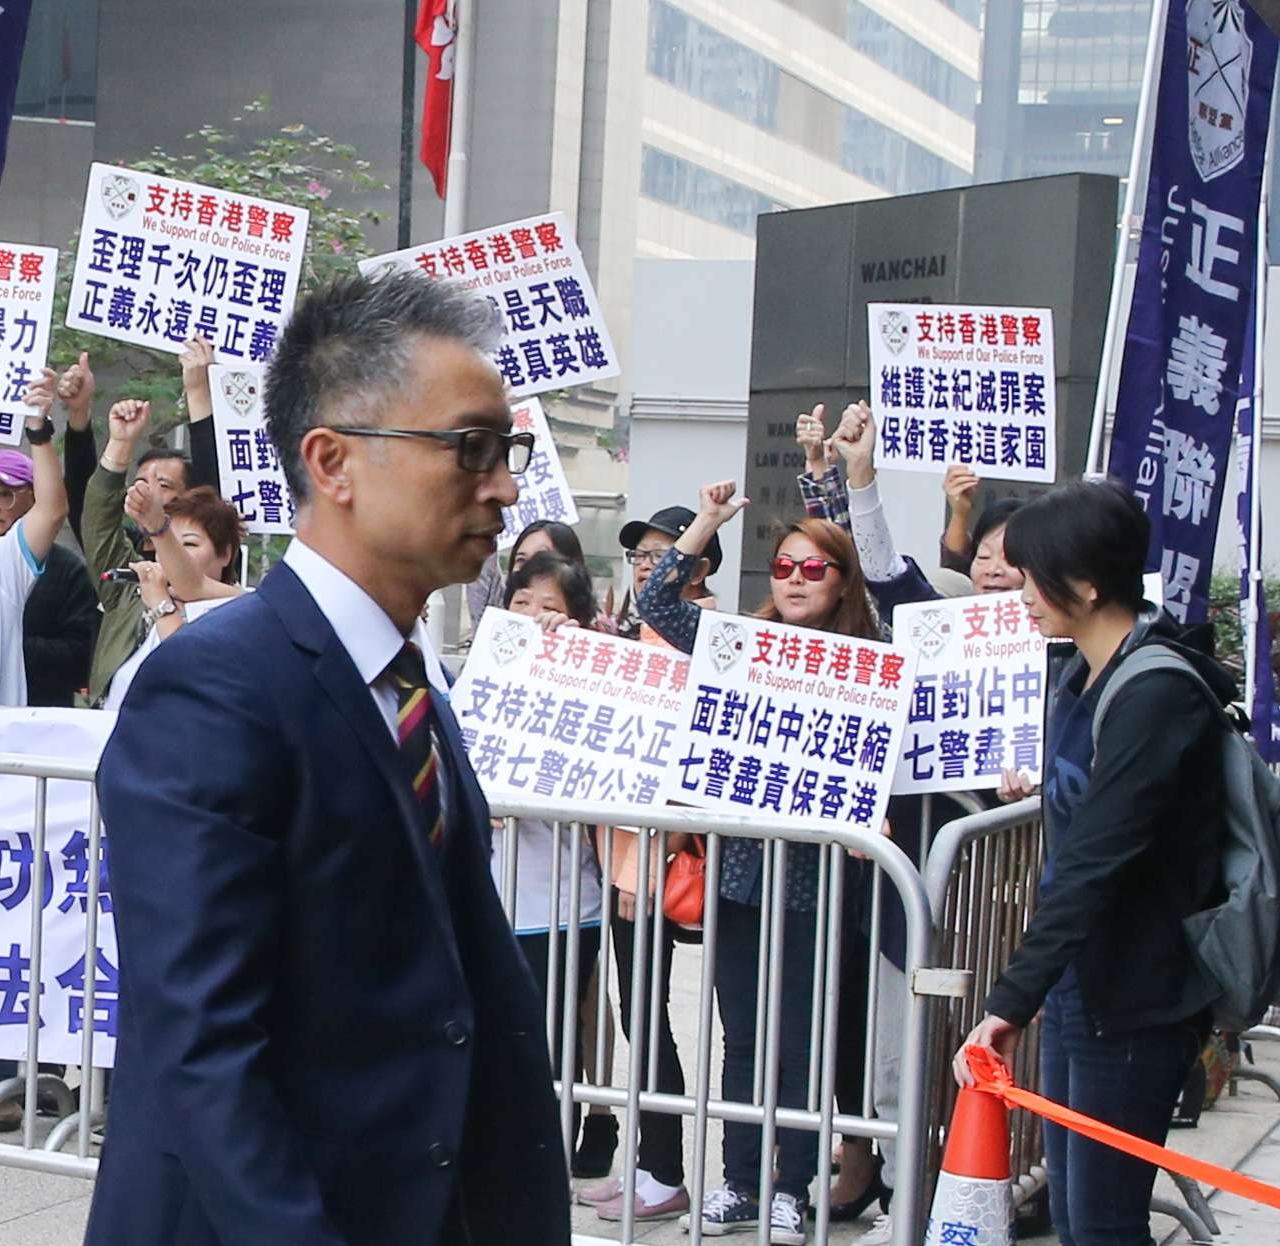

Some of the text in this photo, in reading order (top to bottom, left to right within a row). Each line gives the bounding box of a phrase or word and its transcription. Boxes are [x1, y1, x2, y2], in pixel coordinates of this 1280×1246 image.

[143, 216, 291, 262] We Support of Our Police Force
[146, 183, 295, 244] 支持香港警察
[89, 228, 287, 314] 歪理千次仍歪理
[416, 222, 563, 280] 支持香港警察
[484, 274, 493, 287] of
[494, 270, 512, 283] Our
[513, 262, 543, 278] Police
[545, 256, 572, 272] Force
[861, 255, 947, 284] WANCHAI
[12, 288, 41, 301] Force
[79, 279, 279, 363] 正義永遠是正義
[487, 275, 591, 335] 是天職
[916, 312, 1041, 346] 支持香港警察
[917, 346, 1044, 364] We Support of Our Police Force
[881, 365, 1045, 416] 維護法紀滅罪案
[881, 416, 1045, 469] 保衛香港這家園
[231, 480, 296, 529] 七警
[535, 629, 691, 694] 支持香港警察
[752, 629, 905, 690] 支持香港警察
[964, 643, 981, 659] We
[986, 641, 1030, 659] Support
[529, 663, 681, 712] We Support of Our Police Forc
[748, 667, 897, 712] We Support of Our Police Force
[908, 664, 1041, 724] 面對佔中
[462, 676, 678, 767] 支持法庭是公正
[690, 684, 892, 774] 面對佔中沒退縮
[904, 723, 1041, 780] 七警盡責
[679, 743, 877, 828] 七警盡責保香港
